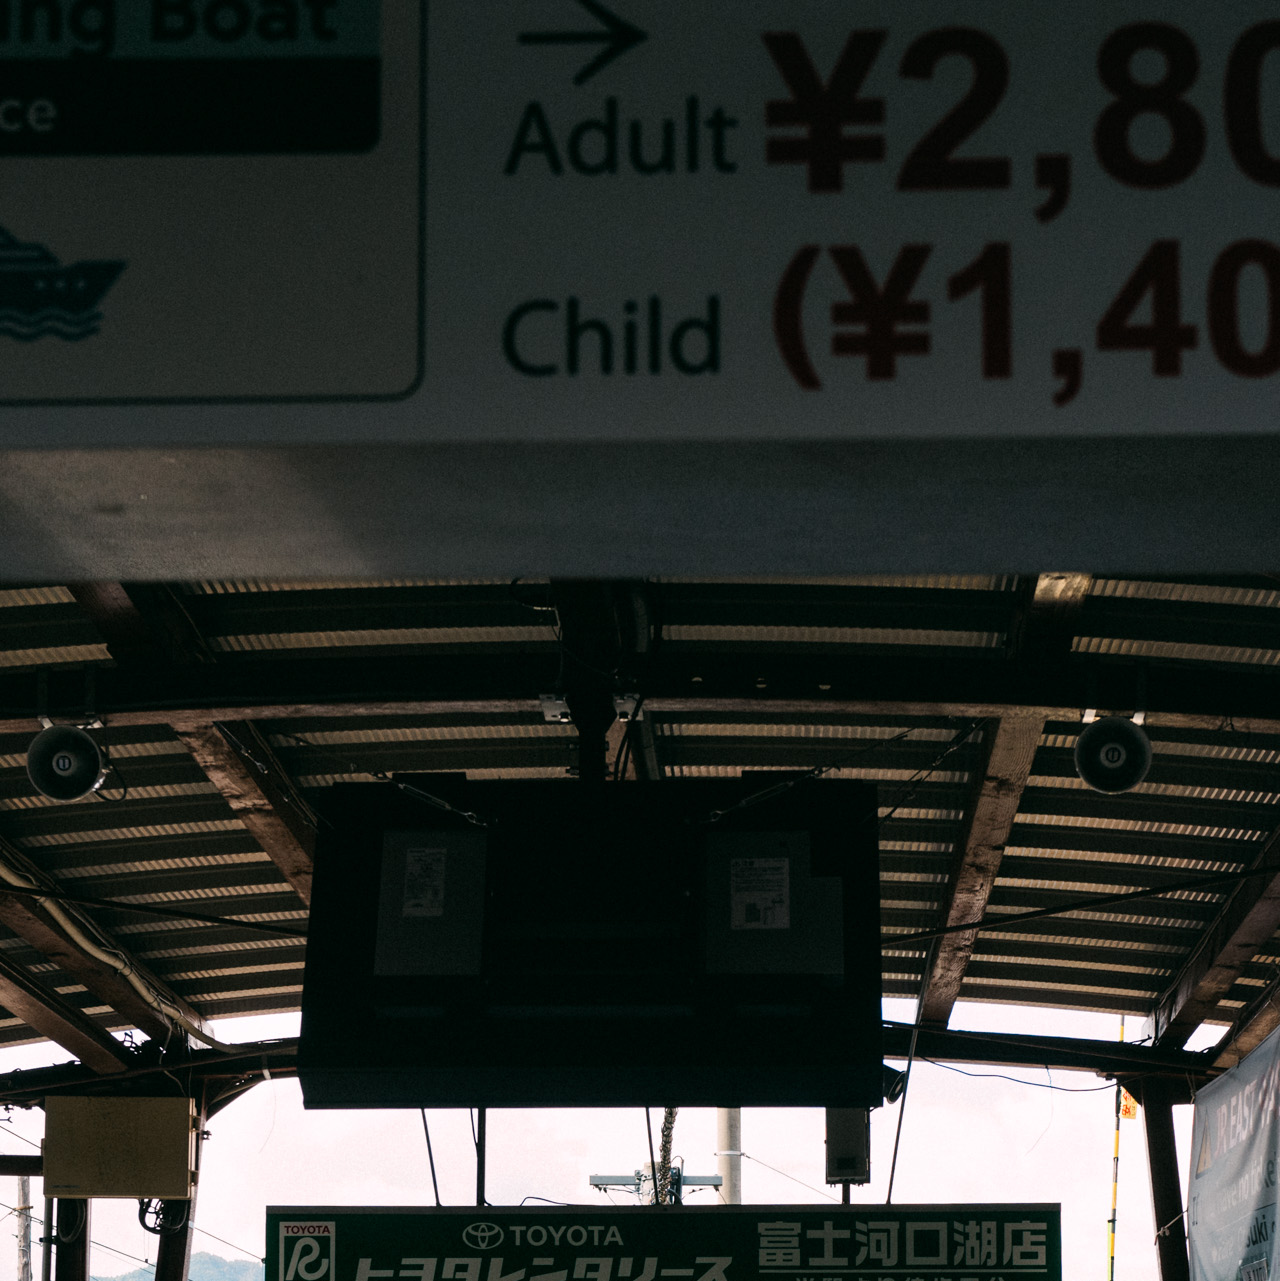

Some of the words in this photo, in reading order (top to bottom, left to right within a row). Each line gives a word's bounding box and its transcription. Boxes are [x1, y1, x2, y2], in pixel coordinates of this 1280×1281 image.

[151, 0, 338, 43] Boat
[504, 95, 739, 177] Adult
[502, 294, 722, 380] Child
[283, 1225, 331, 1235] TOYOTA
[509, 1225, 624, 1247] TOYOTA
[757, 1220, 1048, 1267] 富士河口湖店
